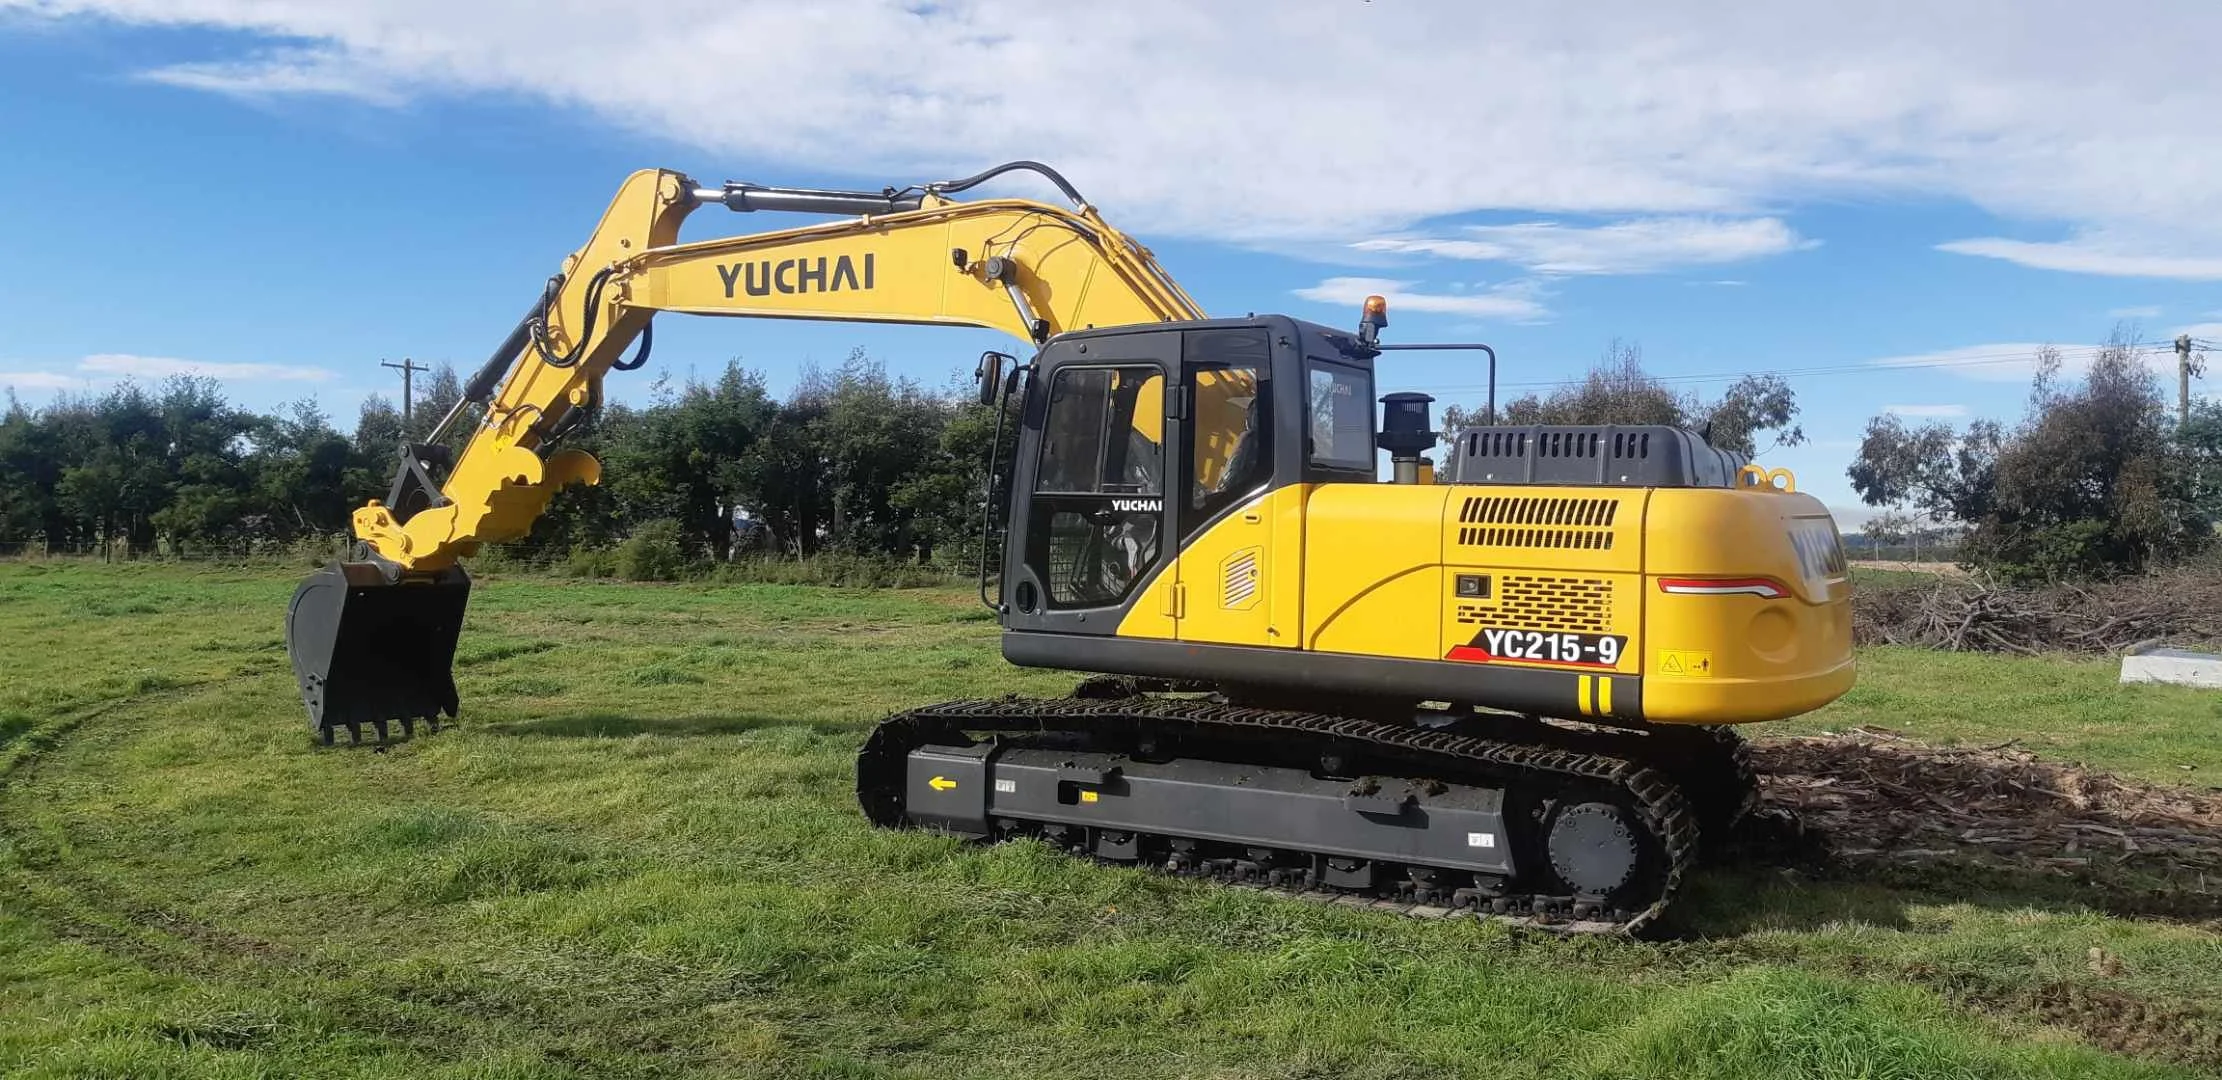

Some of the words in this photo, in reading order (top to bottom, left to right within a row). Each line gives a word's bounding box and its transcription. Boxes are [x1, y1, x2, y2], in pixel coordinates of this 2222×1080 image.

[716, 253, 874, 298] YUCHAI
[1111, 499, 1163, 511] YUCHAI
[1484, 629, 1618, 664] YC215-9
